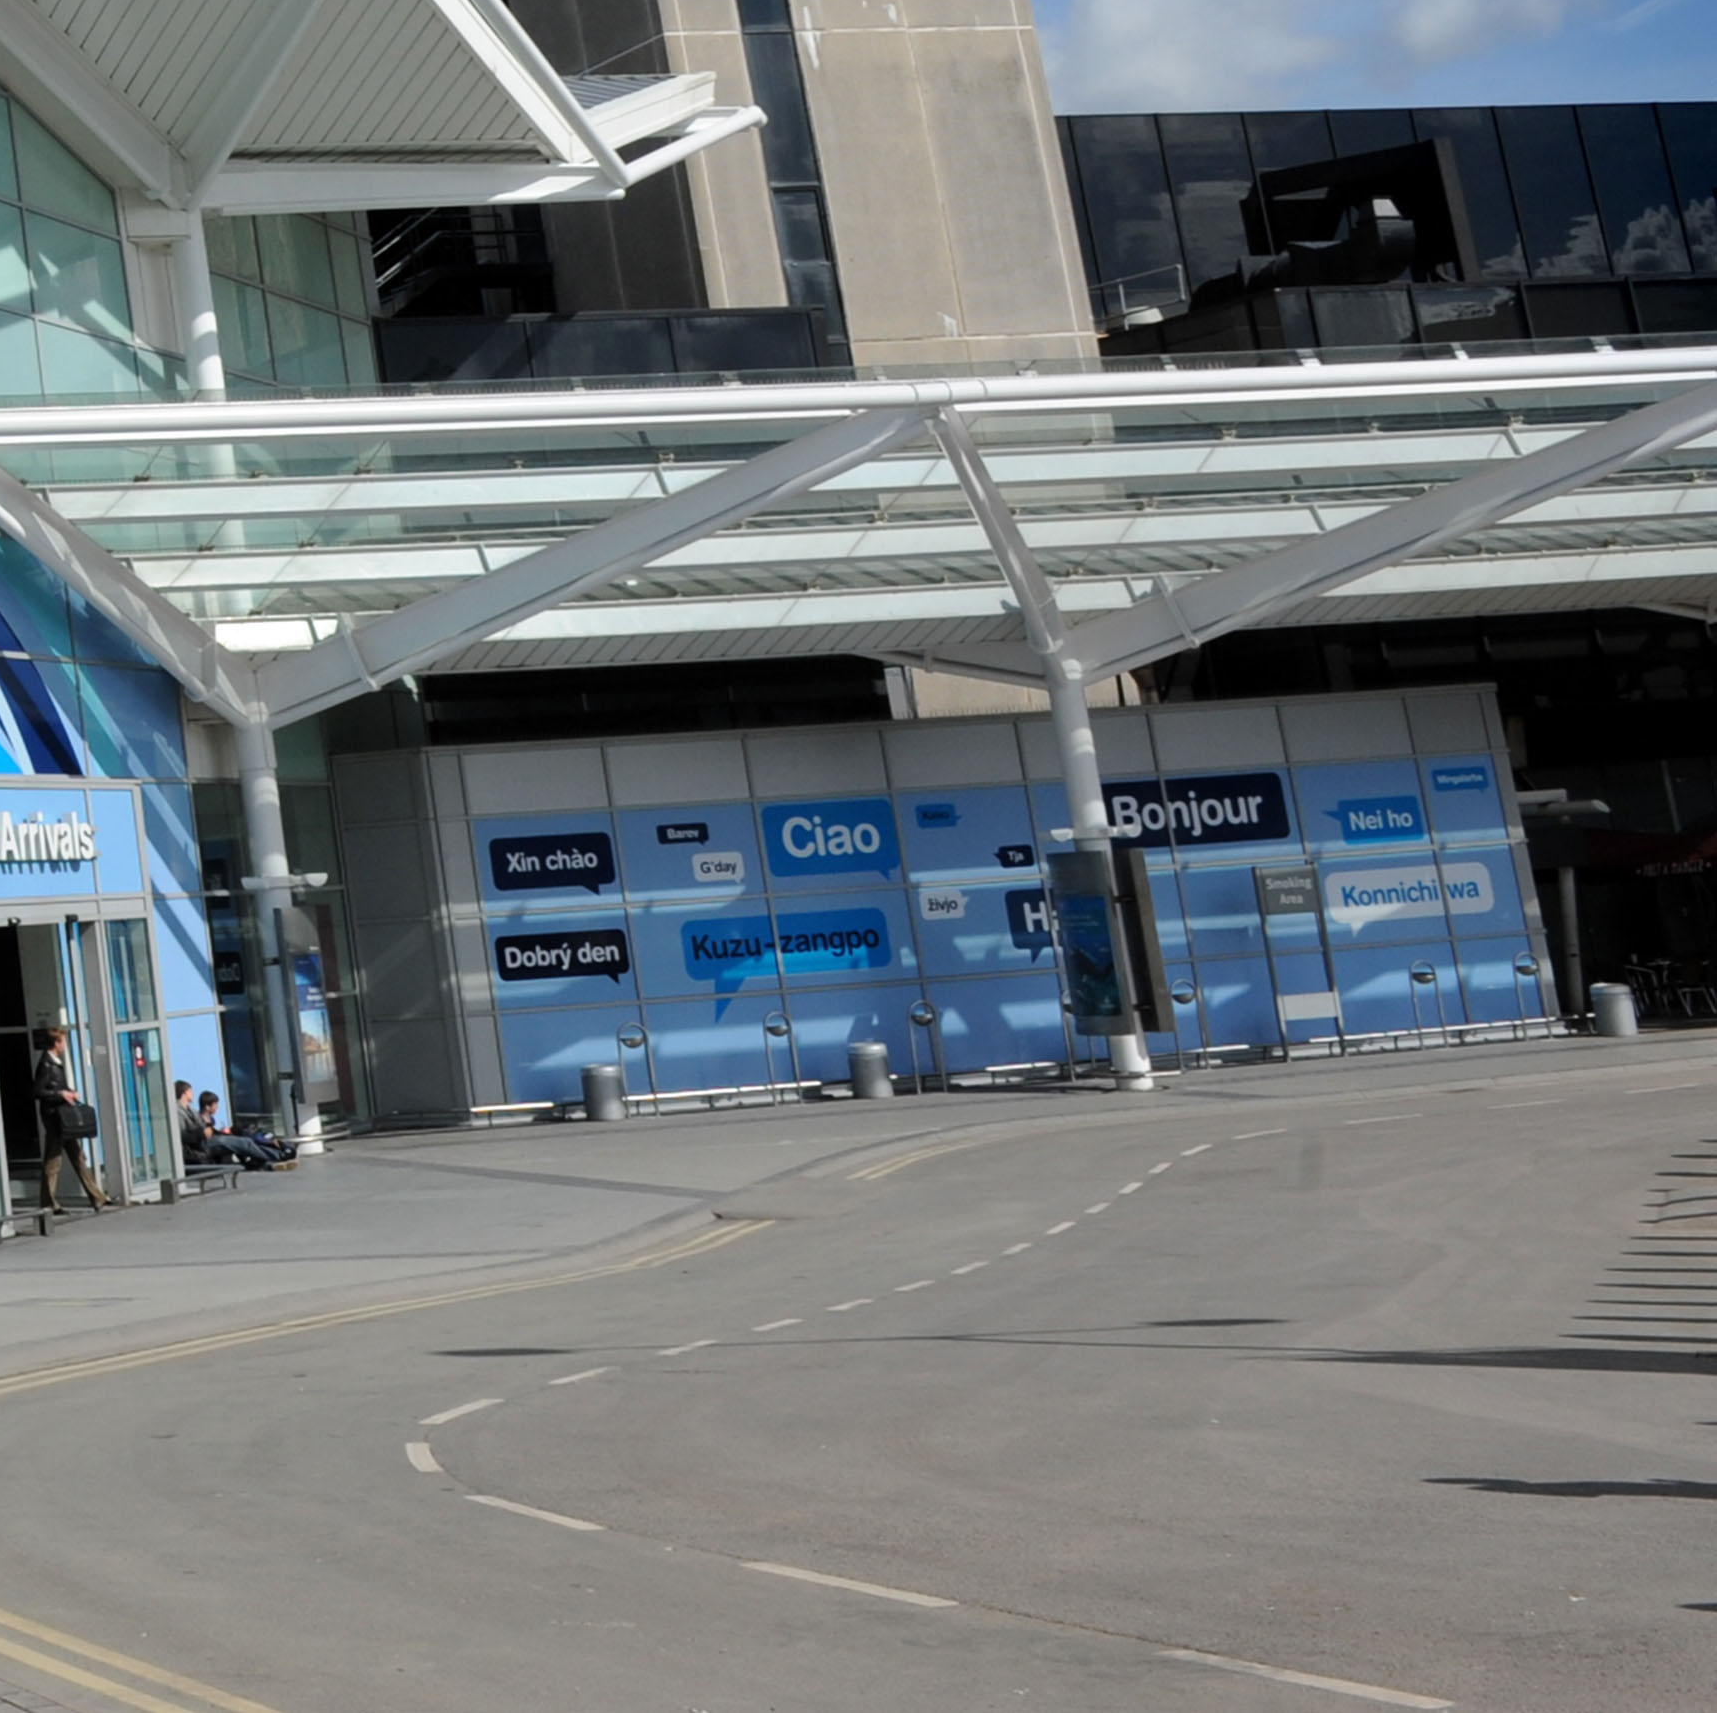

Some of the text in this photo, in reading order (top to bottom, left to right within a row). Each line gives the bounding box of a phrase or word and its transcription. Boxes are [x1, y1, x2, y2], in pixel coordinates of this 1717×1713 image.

[1111, 790, 1263, 838] Bonjour
[1348, 808, 1414, 832] Nei ho
[781, 815, 881, 859] Ciao
[506, 848, 598, 873] Xin chào
[699, 860, 737, 876] G'day
[1266, 877, 1312, 891] Smoking
[1279, 893, 1304, 905] Area
[1023, 900, 1060, 933] Hi
[504, 941, 620, 971] Dobrý den
[691, 928, 880, 962] Kuzu-zangpo
